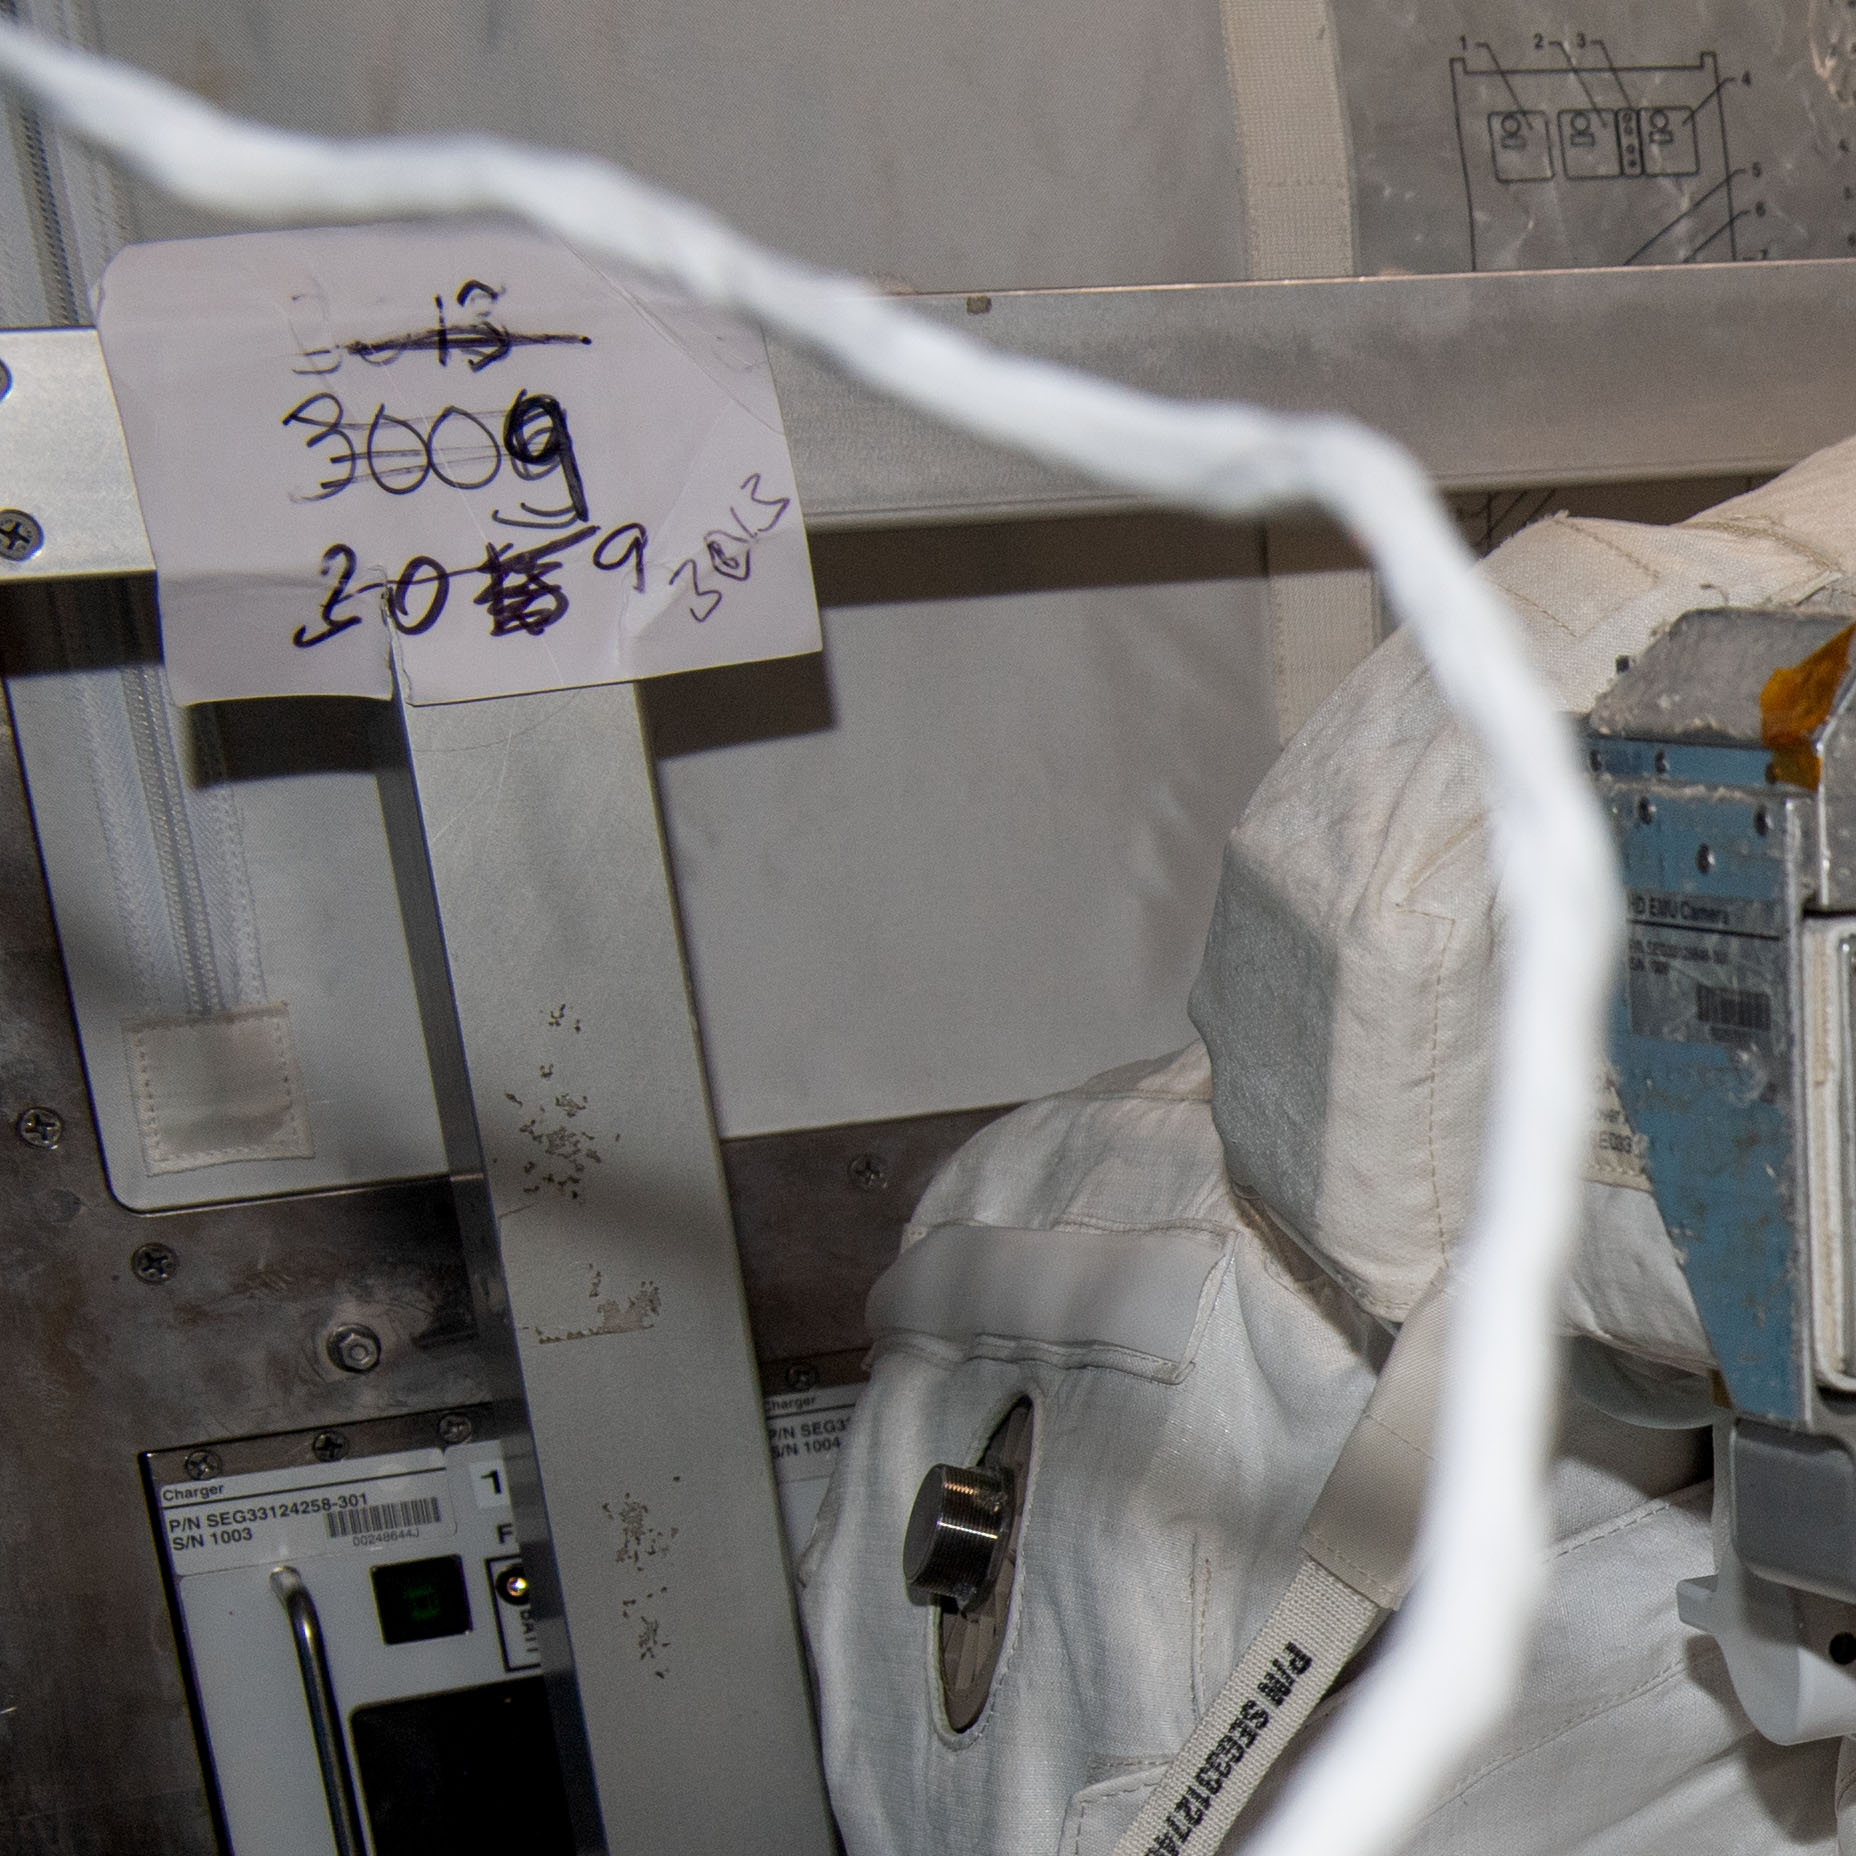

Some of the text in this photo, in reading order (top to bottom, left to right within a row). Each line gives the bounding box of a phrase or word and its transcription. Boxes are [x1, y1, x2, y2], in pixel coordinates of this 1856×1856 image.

[1459, 34, 1468, 50] 1
[1533, 32, 1544, 49] 2
[1576, 31, 1587, 48] 3
[1742, 70, 1751, 86] 4
[1752, 160, 1762, 178] 5
[1755, 200, 1767, 218] 6
[800, 1415, 852, 1438] SEG3
[480, 1468, 502, 1495] 1
[162, 1482, 225, 1503] Charger
[168, 1491, 369, 1534] P/N SEG33124258-301
[171, 1526, 254, 1552] S/N 1003
[1256, 1639, 1314, 1708] P/N
